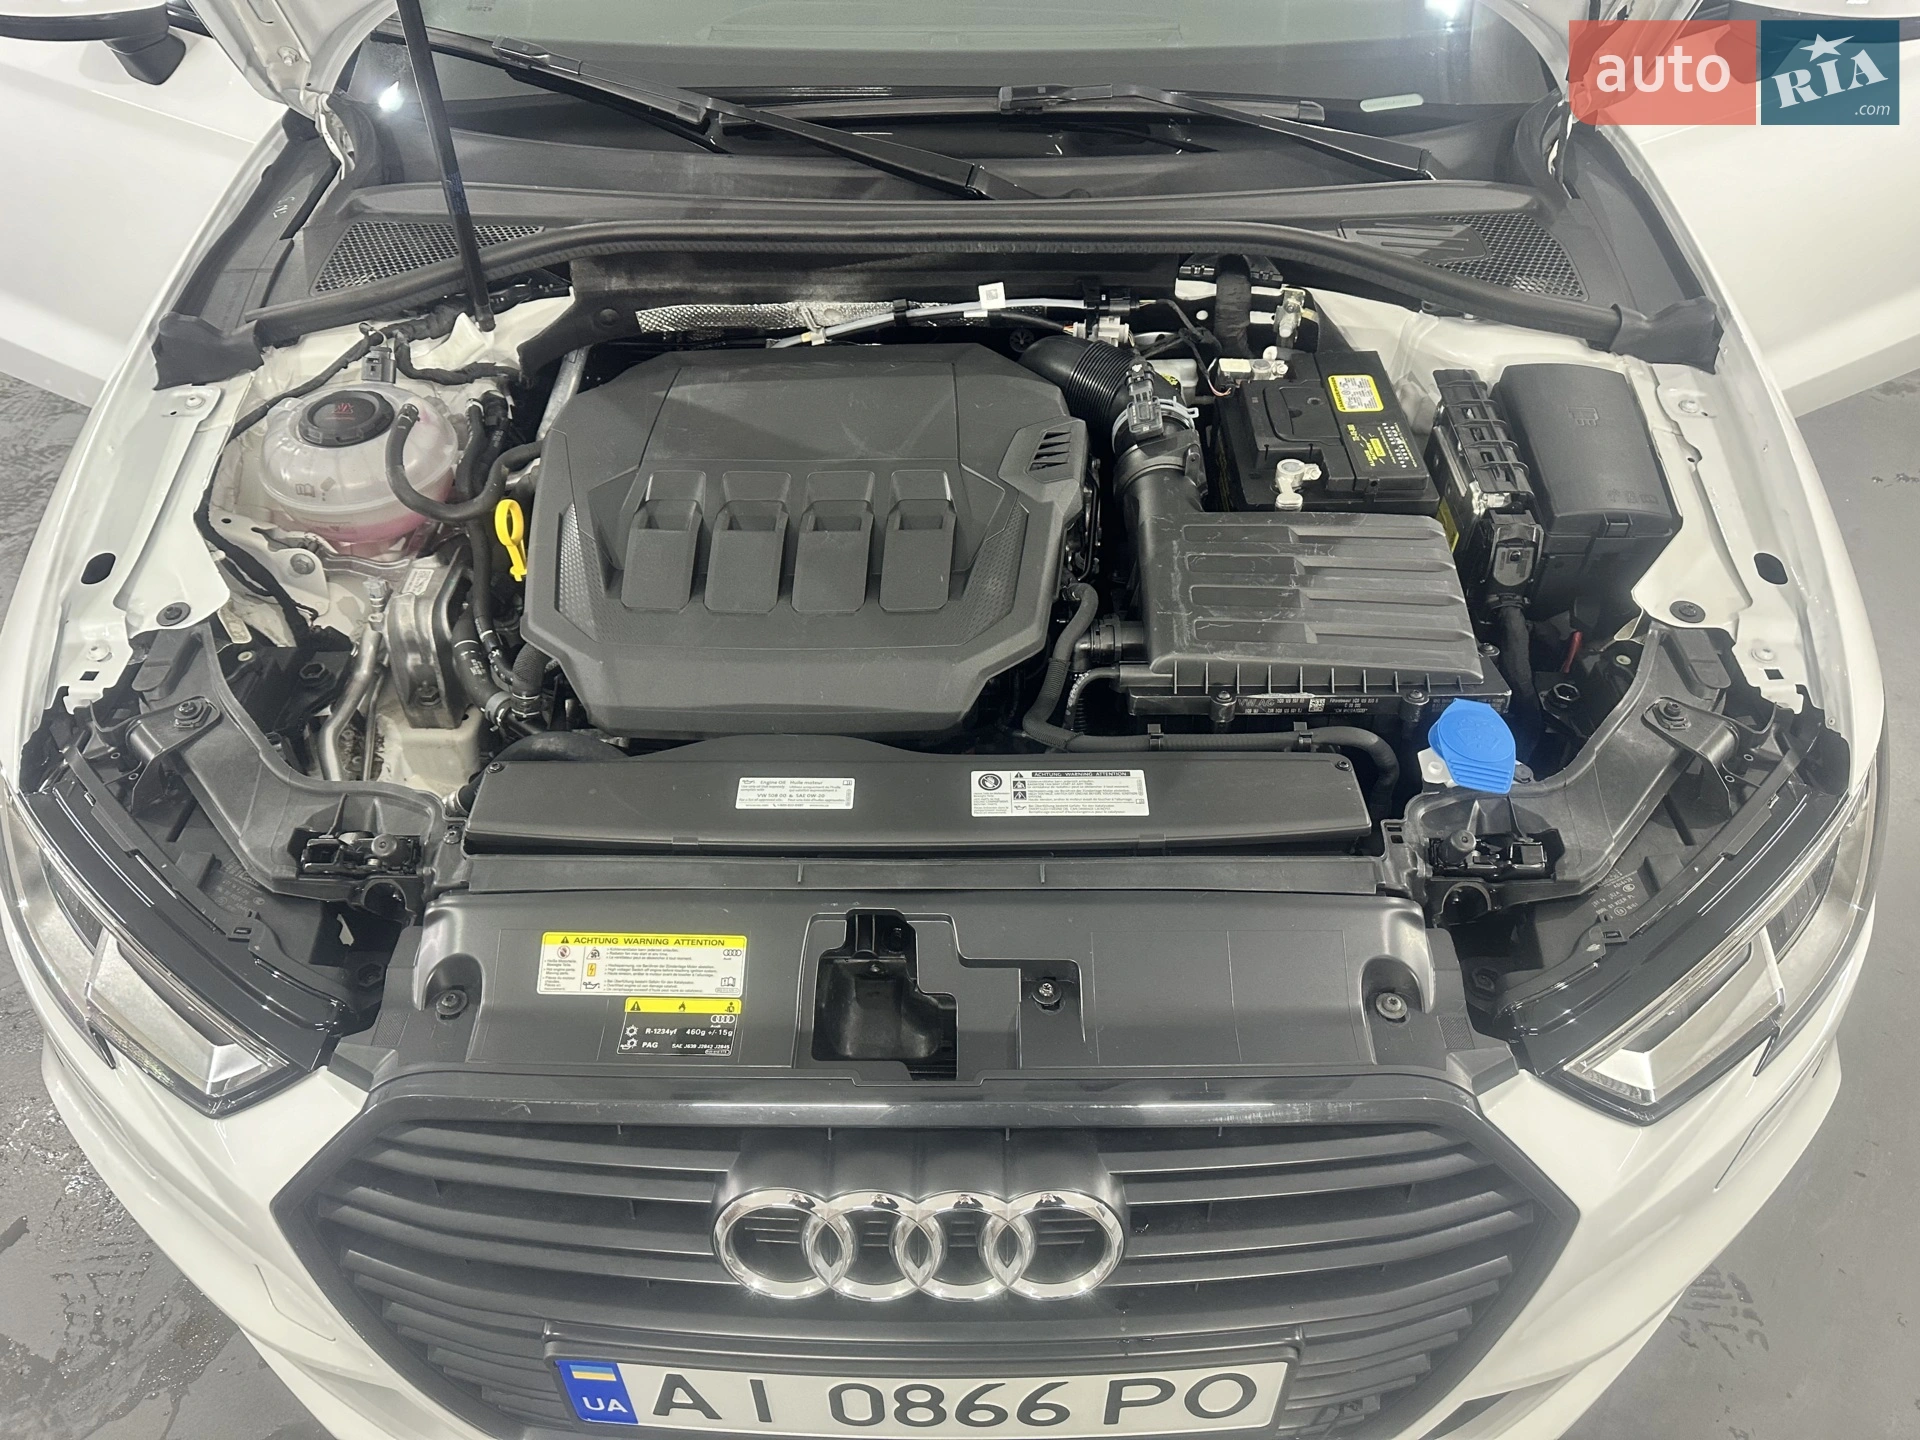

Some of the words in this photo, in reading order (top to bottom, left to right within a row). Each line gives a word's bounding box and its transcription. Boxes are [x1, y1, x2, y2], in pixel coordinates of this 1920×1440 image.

[573, 937, 619, 946] ACHTUNG
[623, 938, 669, 947] WARNING
[674, 938, 725, 947] ATTENTION
[645, 1028, 677, 1036] R-1234yf
[685, 1029, 706, 1037] 460g
[582, 1396, 628, 1413] UA
[653, 1373, 773, 1423] AI
[828, 1381, 1071, 1428] 0866
[1103, 1372, 1258, 1425] PO
